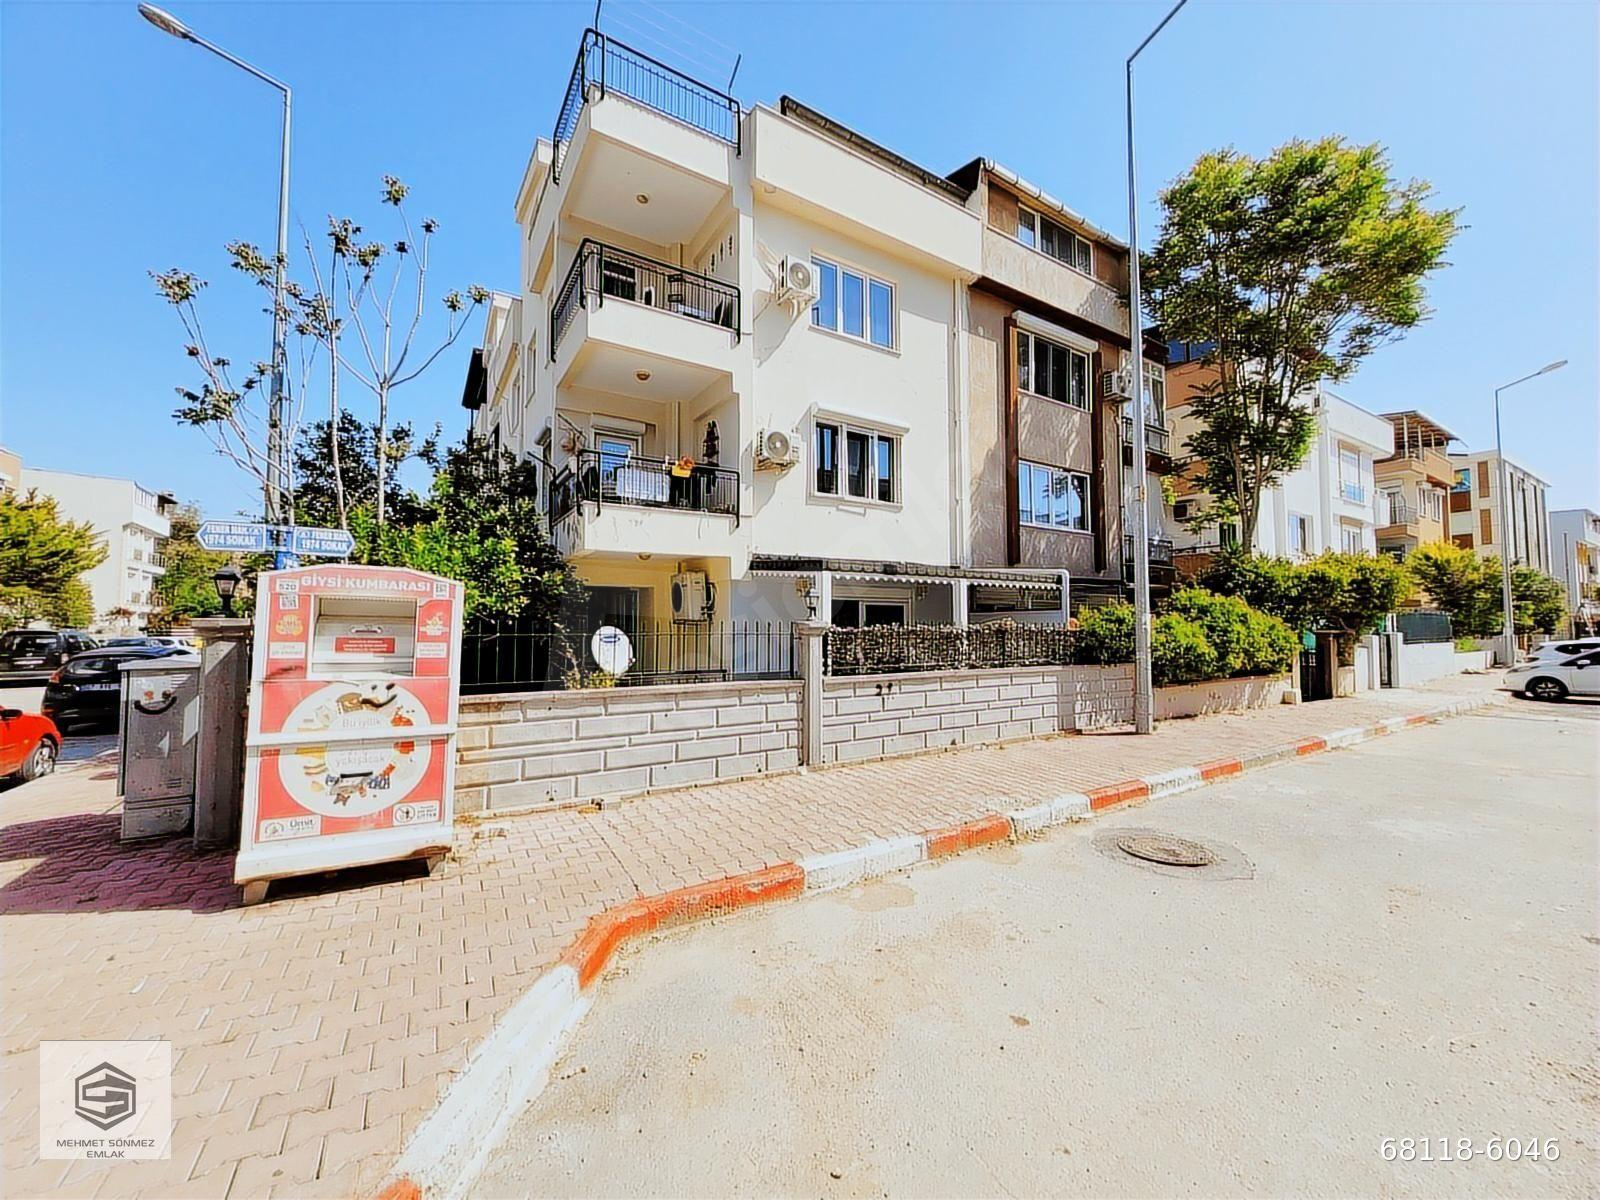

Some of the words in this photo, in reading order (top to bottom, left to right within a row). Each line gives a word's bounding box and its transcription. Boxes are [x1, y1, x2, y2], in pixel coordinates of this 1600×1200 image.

[227, 535, 256, 546] SOKAK
[322, 540, 348, 552] SOKAK
[301, 573, 341, 588] GİYSİ
[345, 578, 430, 592] KUMBARASI
